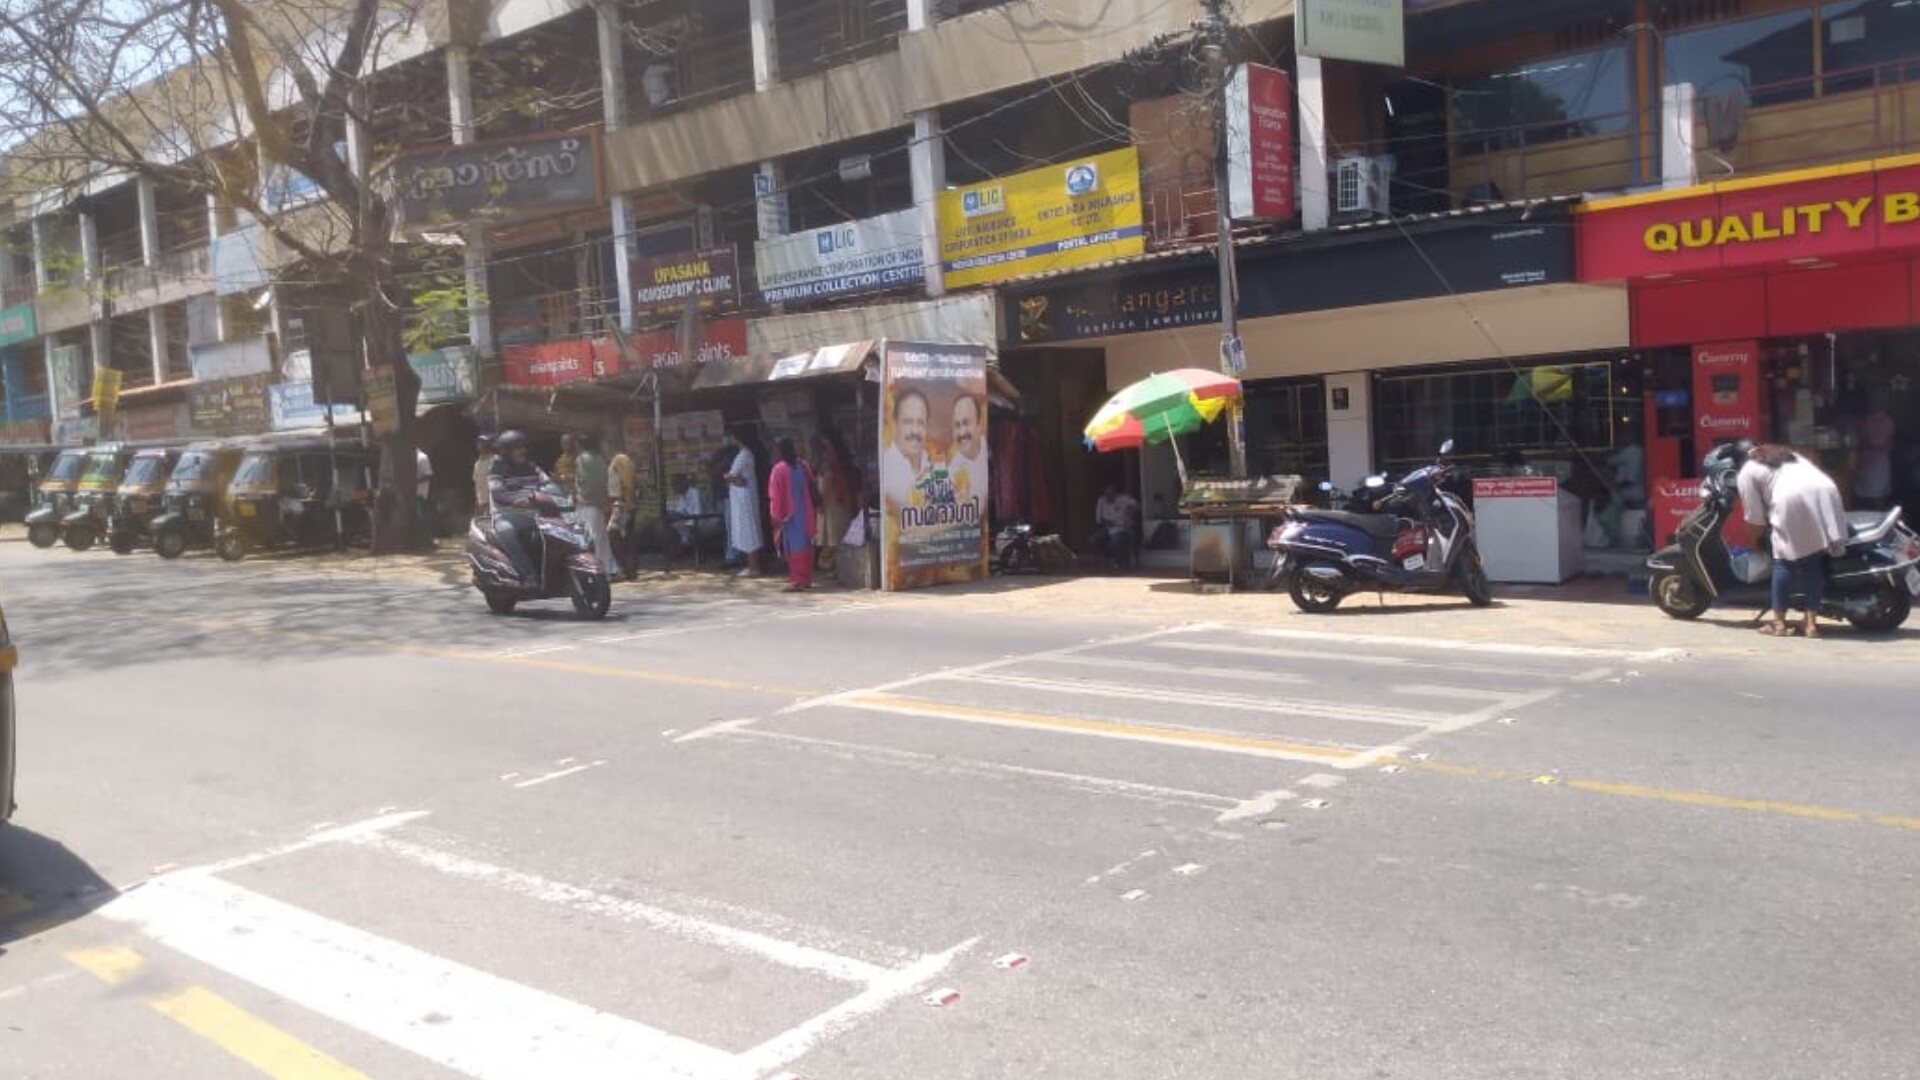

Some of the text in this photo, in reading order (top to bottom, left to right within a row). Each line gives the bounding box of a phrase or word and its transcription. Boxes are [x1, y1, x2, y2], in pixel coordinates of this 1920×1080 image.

[980, 189, 999, 206] LIC
[1643, 196, 1873, 252] QUALITY
[835, 229, 855, 249] LIC
[654, 261, 711, 284] UPASANA
[703, 275, 732, 293] CLINIC
[764, 265, 924, 302] PREMIUM COLLECTION CENTRE
